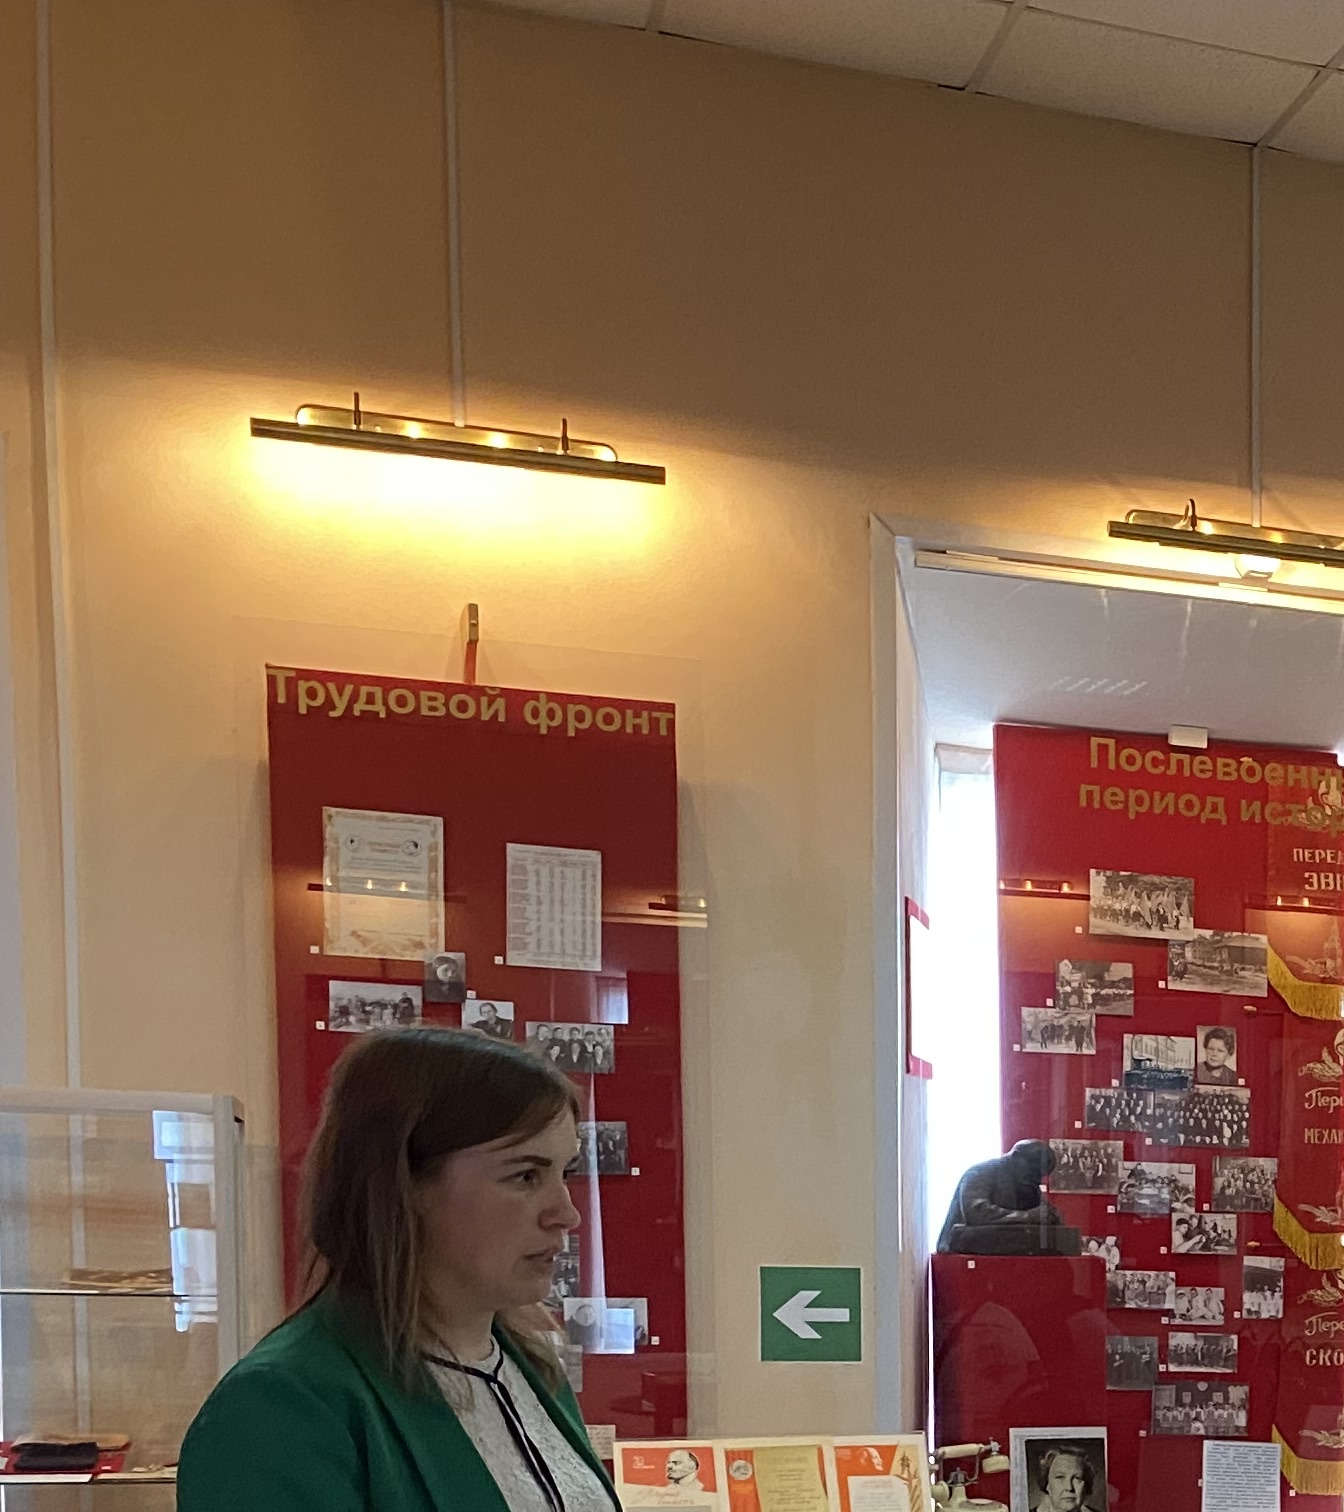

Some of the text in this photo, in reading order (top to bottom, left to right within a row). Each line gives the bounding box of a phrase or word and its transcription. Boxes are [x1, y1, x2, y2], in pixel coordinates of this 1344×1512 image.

[267, 667, 674, 736] Трудовой фронт
[1079, 784, 1227, 825] период
